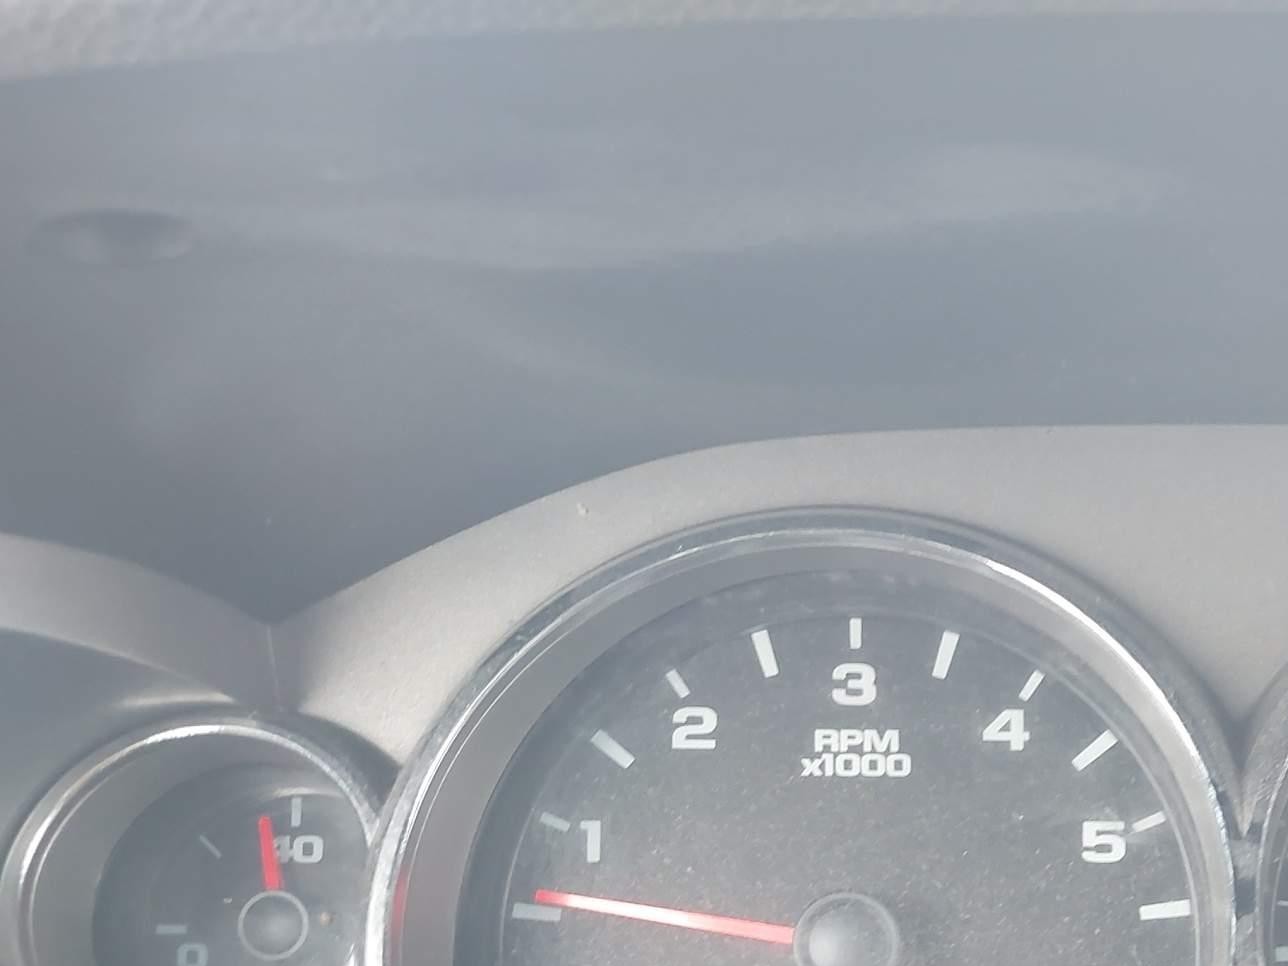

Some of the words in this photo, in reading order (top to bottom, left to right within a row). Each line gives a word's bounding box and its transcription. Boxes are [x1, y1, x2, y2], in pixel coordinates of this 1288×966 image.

[832, 663, 877, 705] 3
[672, 706, 717, 749] 2
[814, 729, 900, 752] RPM
[983, 709, 1030, 751] 4
[801, 753, 911, 778] x1000
[579, 820, 601, 862] 1
[1082, 821, 1126, 862] 5
